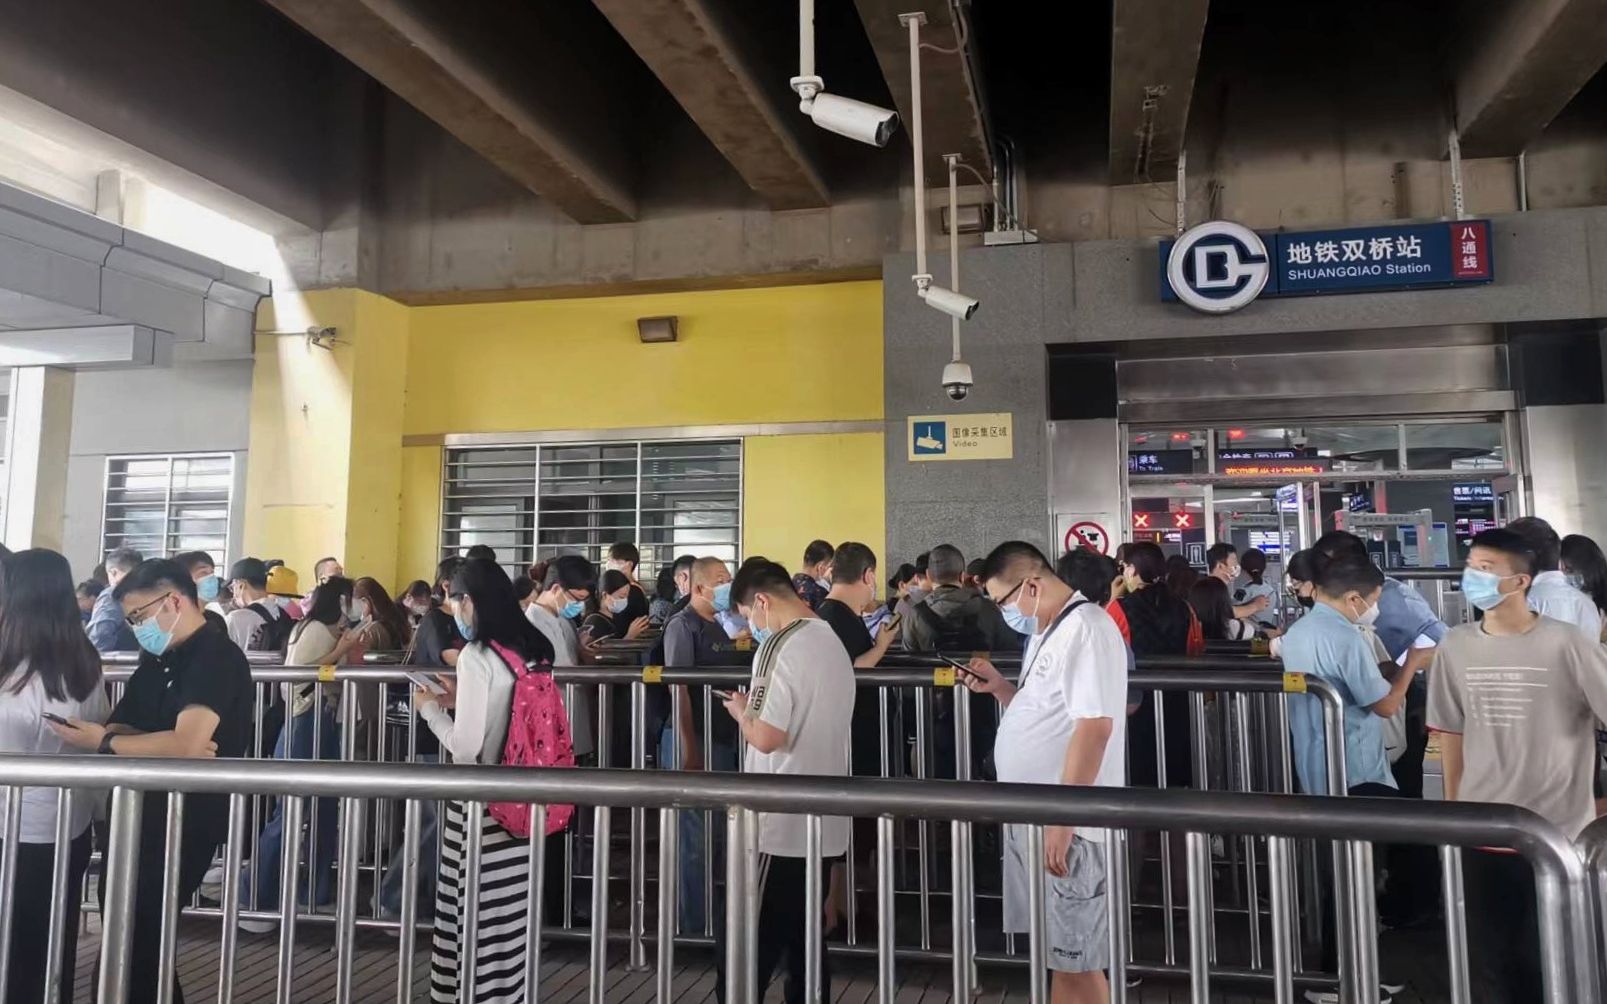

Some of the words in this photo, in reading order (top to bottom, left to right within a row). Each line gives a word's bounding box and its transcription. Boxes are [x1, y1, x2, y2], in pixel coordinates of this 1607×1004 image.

[1287, 235, 1422, 264] 地铁双桥站
[1461, 227, 1478, 269] 八通线
[1288, 265, 1381, 280] SHUANGQIAO
[1386, 263, 1431, 275] Station
[952, 426, 1008, 438] 图像采集区域
